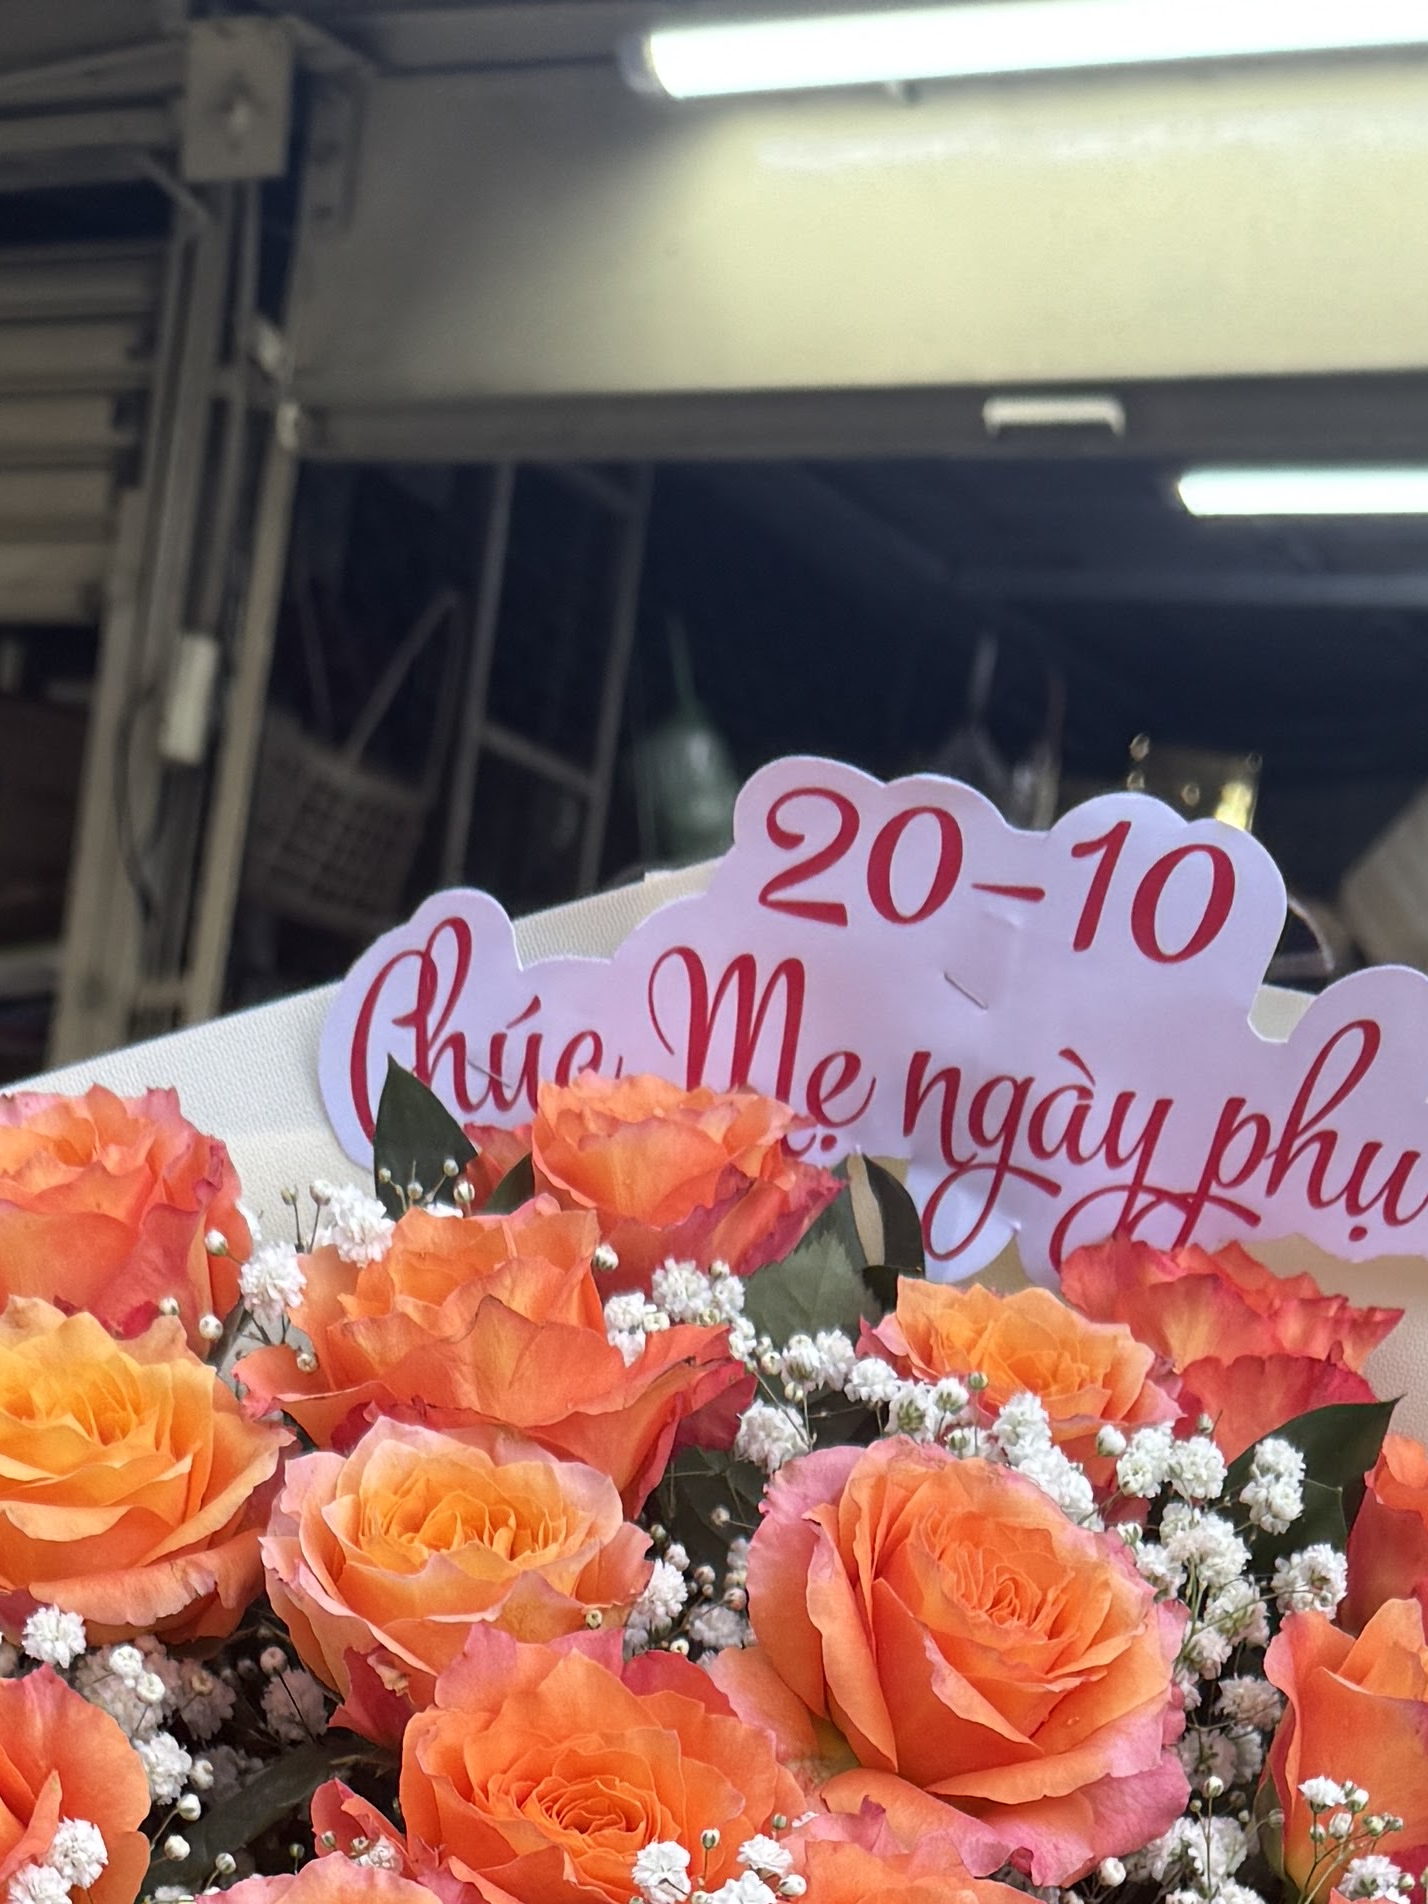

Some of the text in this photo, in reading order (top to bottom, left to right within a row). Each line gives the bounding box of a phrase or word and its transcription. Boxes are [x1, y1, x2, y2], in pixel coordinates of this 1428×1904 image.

[758, 786, 1236, 964] 20-10
[647, 946, 877, 1158] Mẹ
[903, 1047, 1194, 1274] ngày
